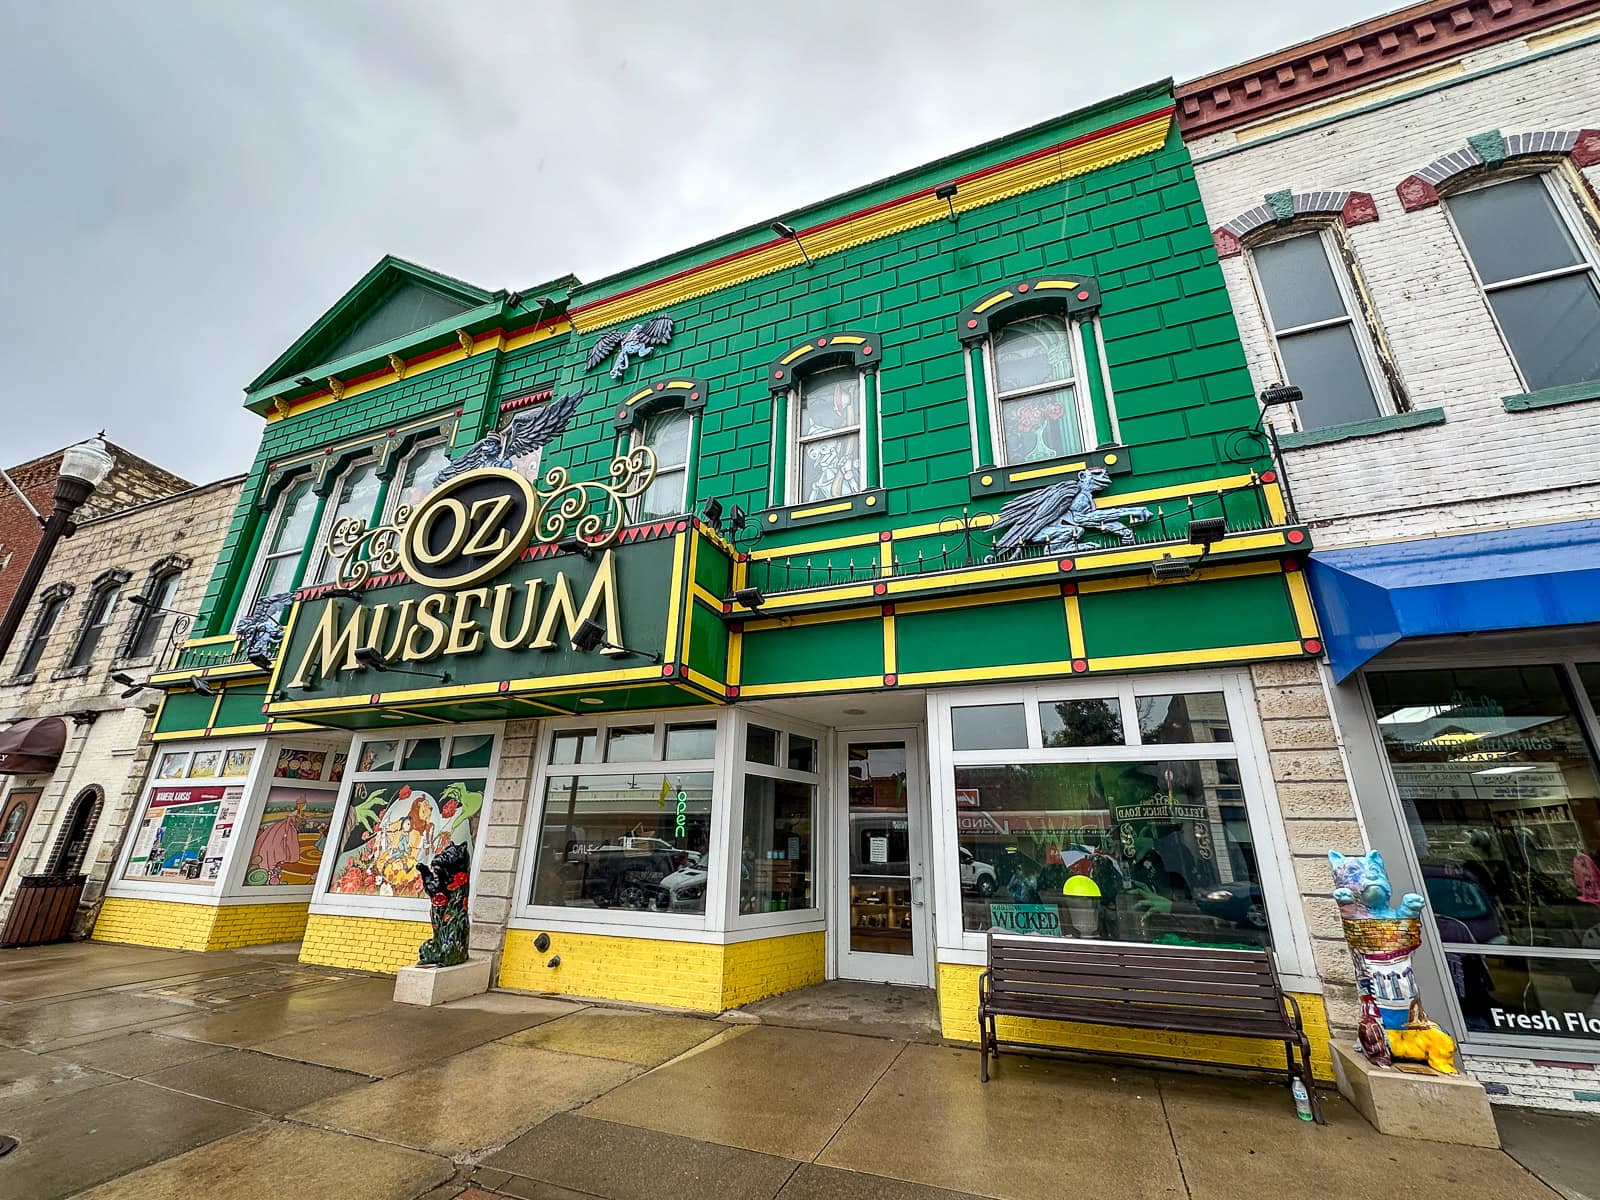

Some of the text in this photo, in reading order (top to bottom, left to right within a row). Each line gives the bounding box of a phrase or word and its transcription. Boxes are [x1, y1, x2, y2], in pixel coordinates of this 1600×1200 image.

[413, 494, 513, 565] OZ
[287, 549, 625, 689] MUSEUM
[992, 911, 1059, 930] WICKED
[1490, 1007, 1561, 1031] Fresh
